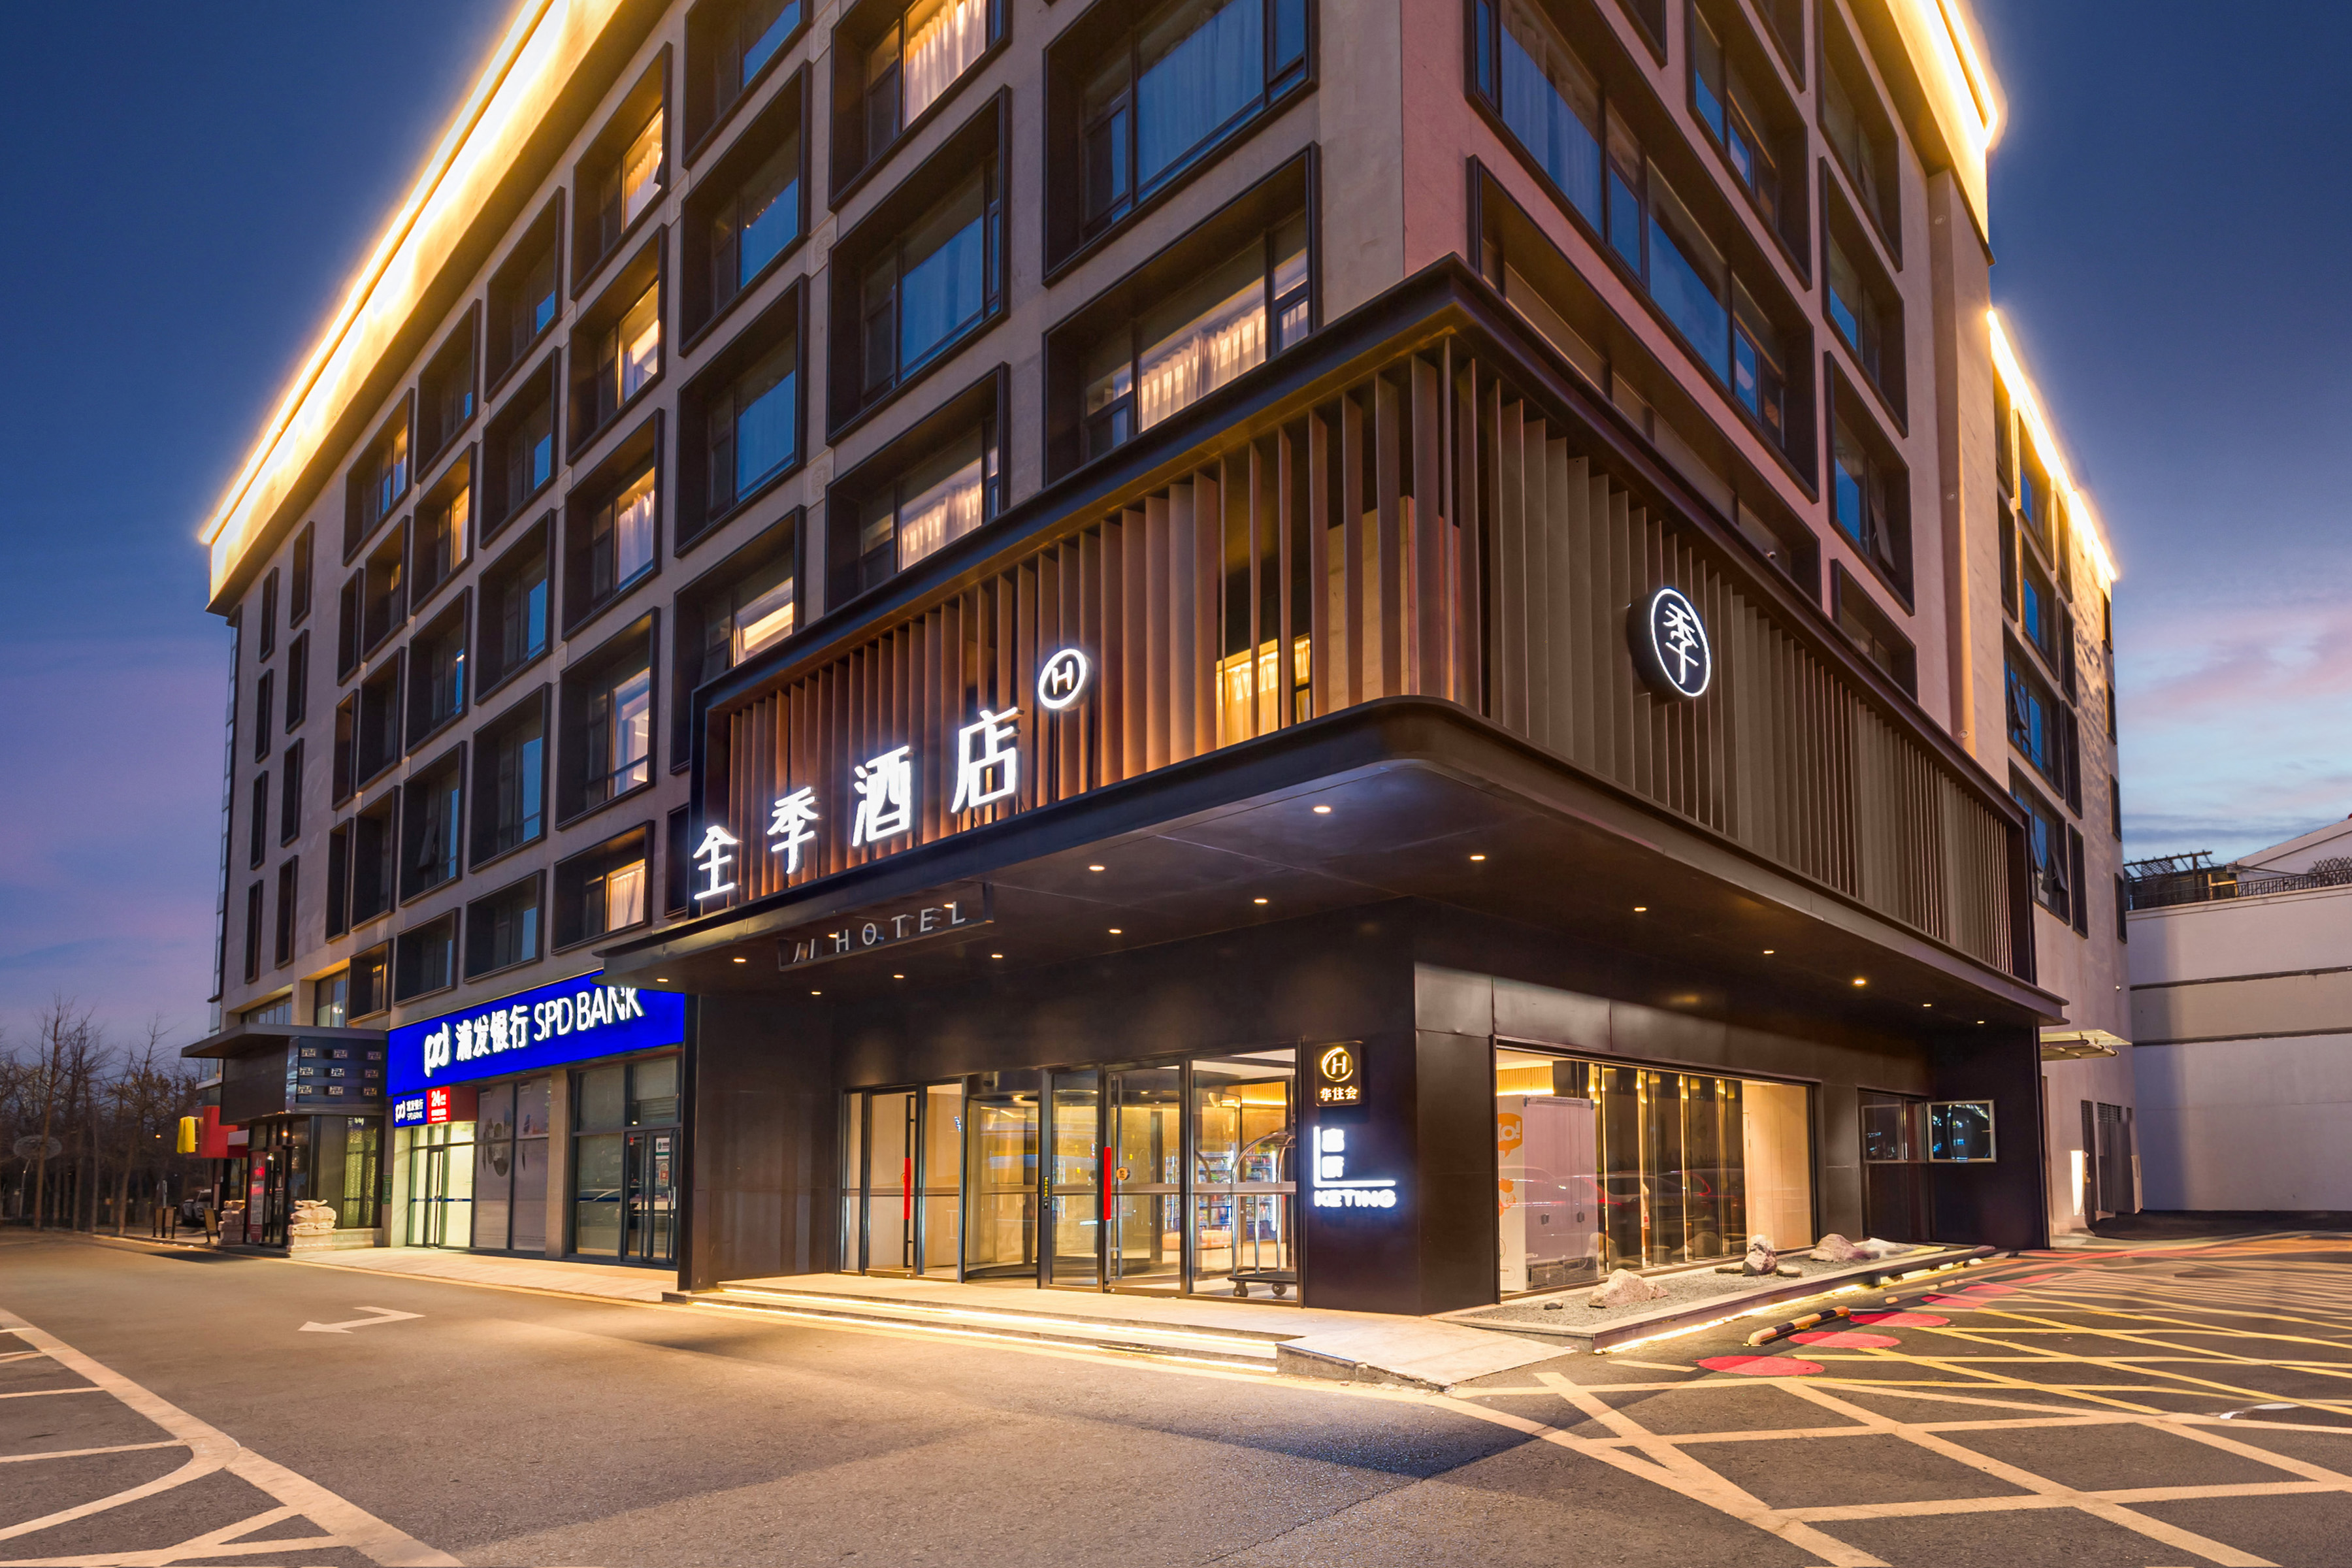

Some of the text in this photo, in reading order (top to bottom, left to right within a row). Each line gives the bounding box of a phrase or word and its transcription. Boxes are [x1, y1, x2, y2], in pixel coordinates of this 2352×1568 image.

[1663, 602, 1699, 685] 季
[693, 706, 1021, 900] 全季酒店
[835, 901, 966, 954] HOTEL
[455, 1004, 529, 1062] 浦发银行
[533, 986, 644, 1041] SPD BANK
[431, 1090, 440, 1107] 24
[1320, 1085, 1358, 1102] 华住会
[1314, 1188, 1397, 1208] KETING
